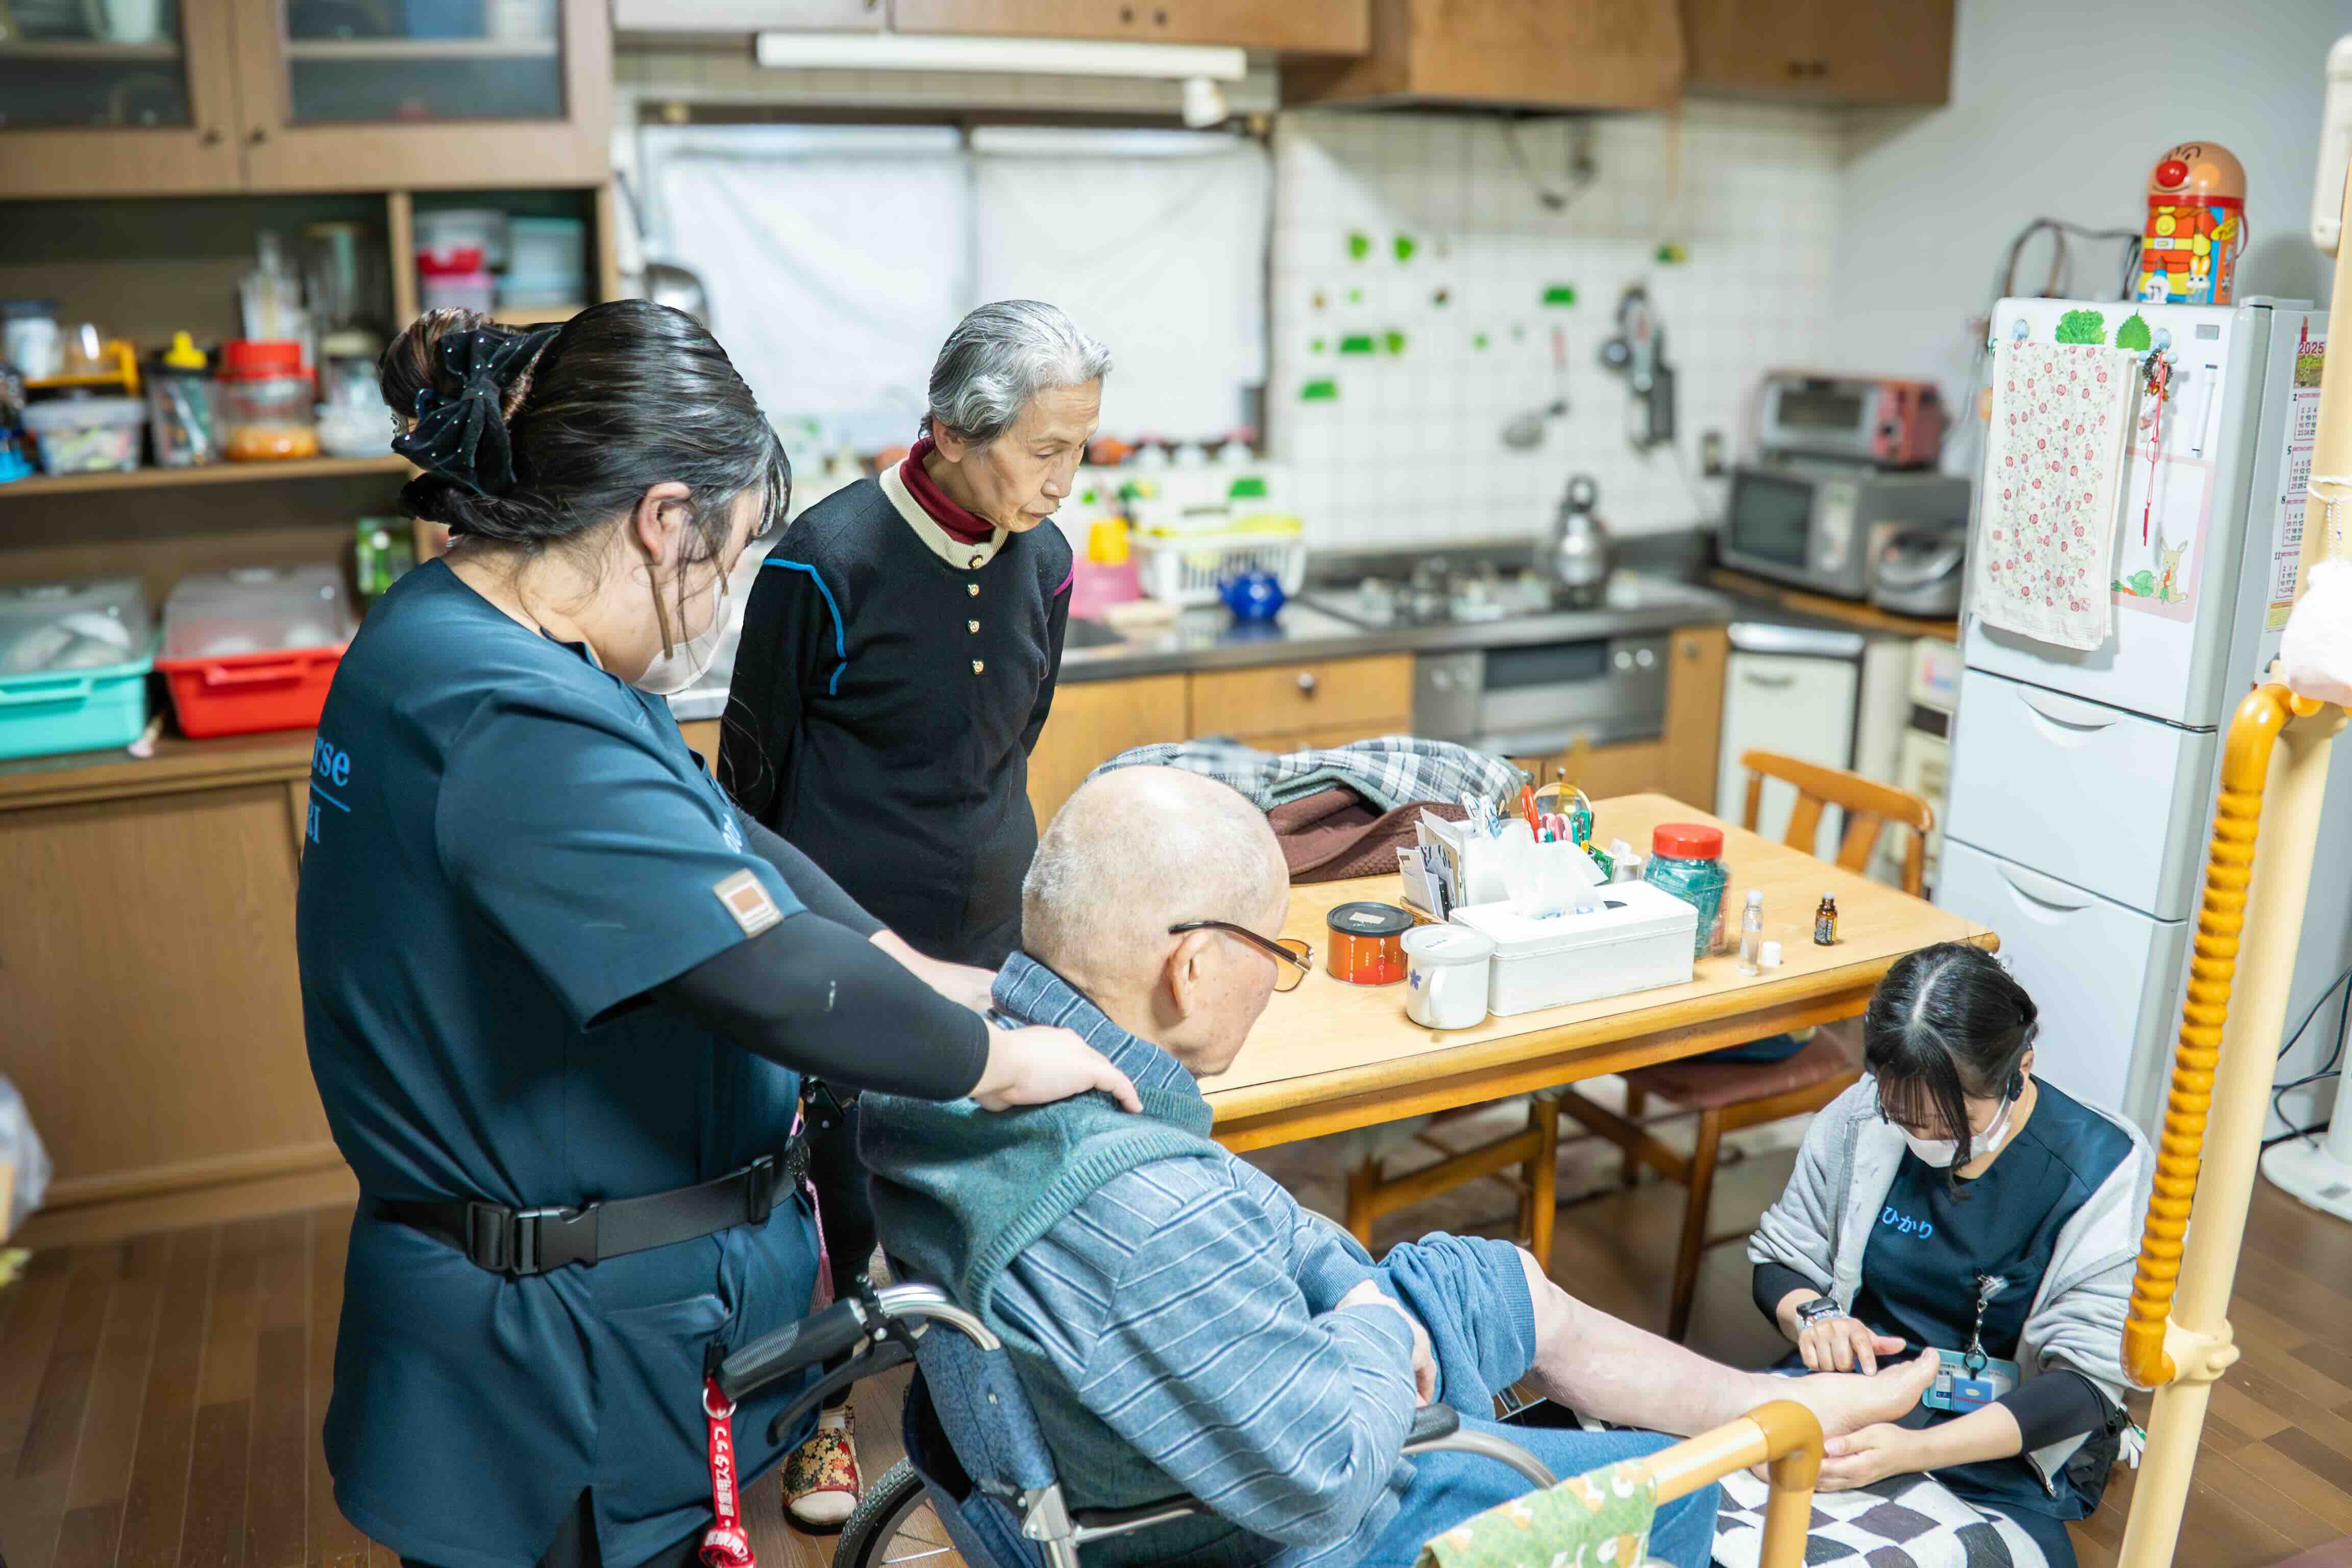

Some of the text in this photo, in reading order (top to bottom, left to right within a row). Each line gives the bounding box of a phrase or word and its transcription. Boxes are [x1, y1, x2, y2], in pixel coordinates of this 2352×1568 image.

[2298, 341, 2324, 355] 2025
[2292, 393, 2297, 401] 2
[2287, 445, 2292, 455] 5
[2281, 496, 2286, 504] 8
[2274, 551, 2281, 560] 11
[1882, 1206, 1933, 1240] ひかり
